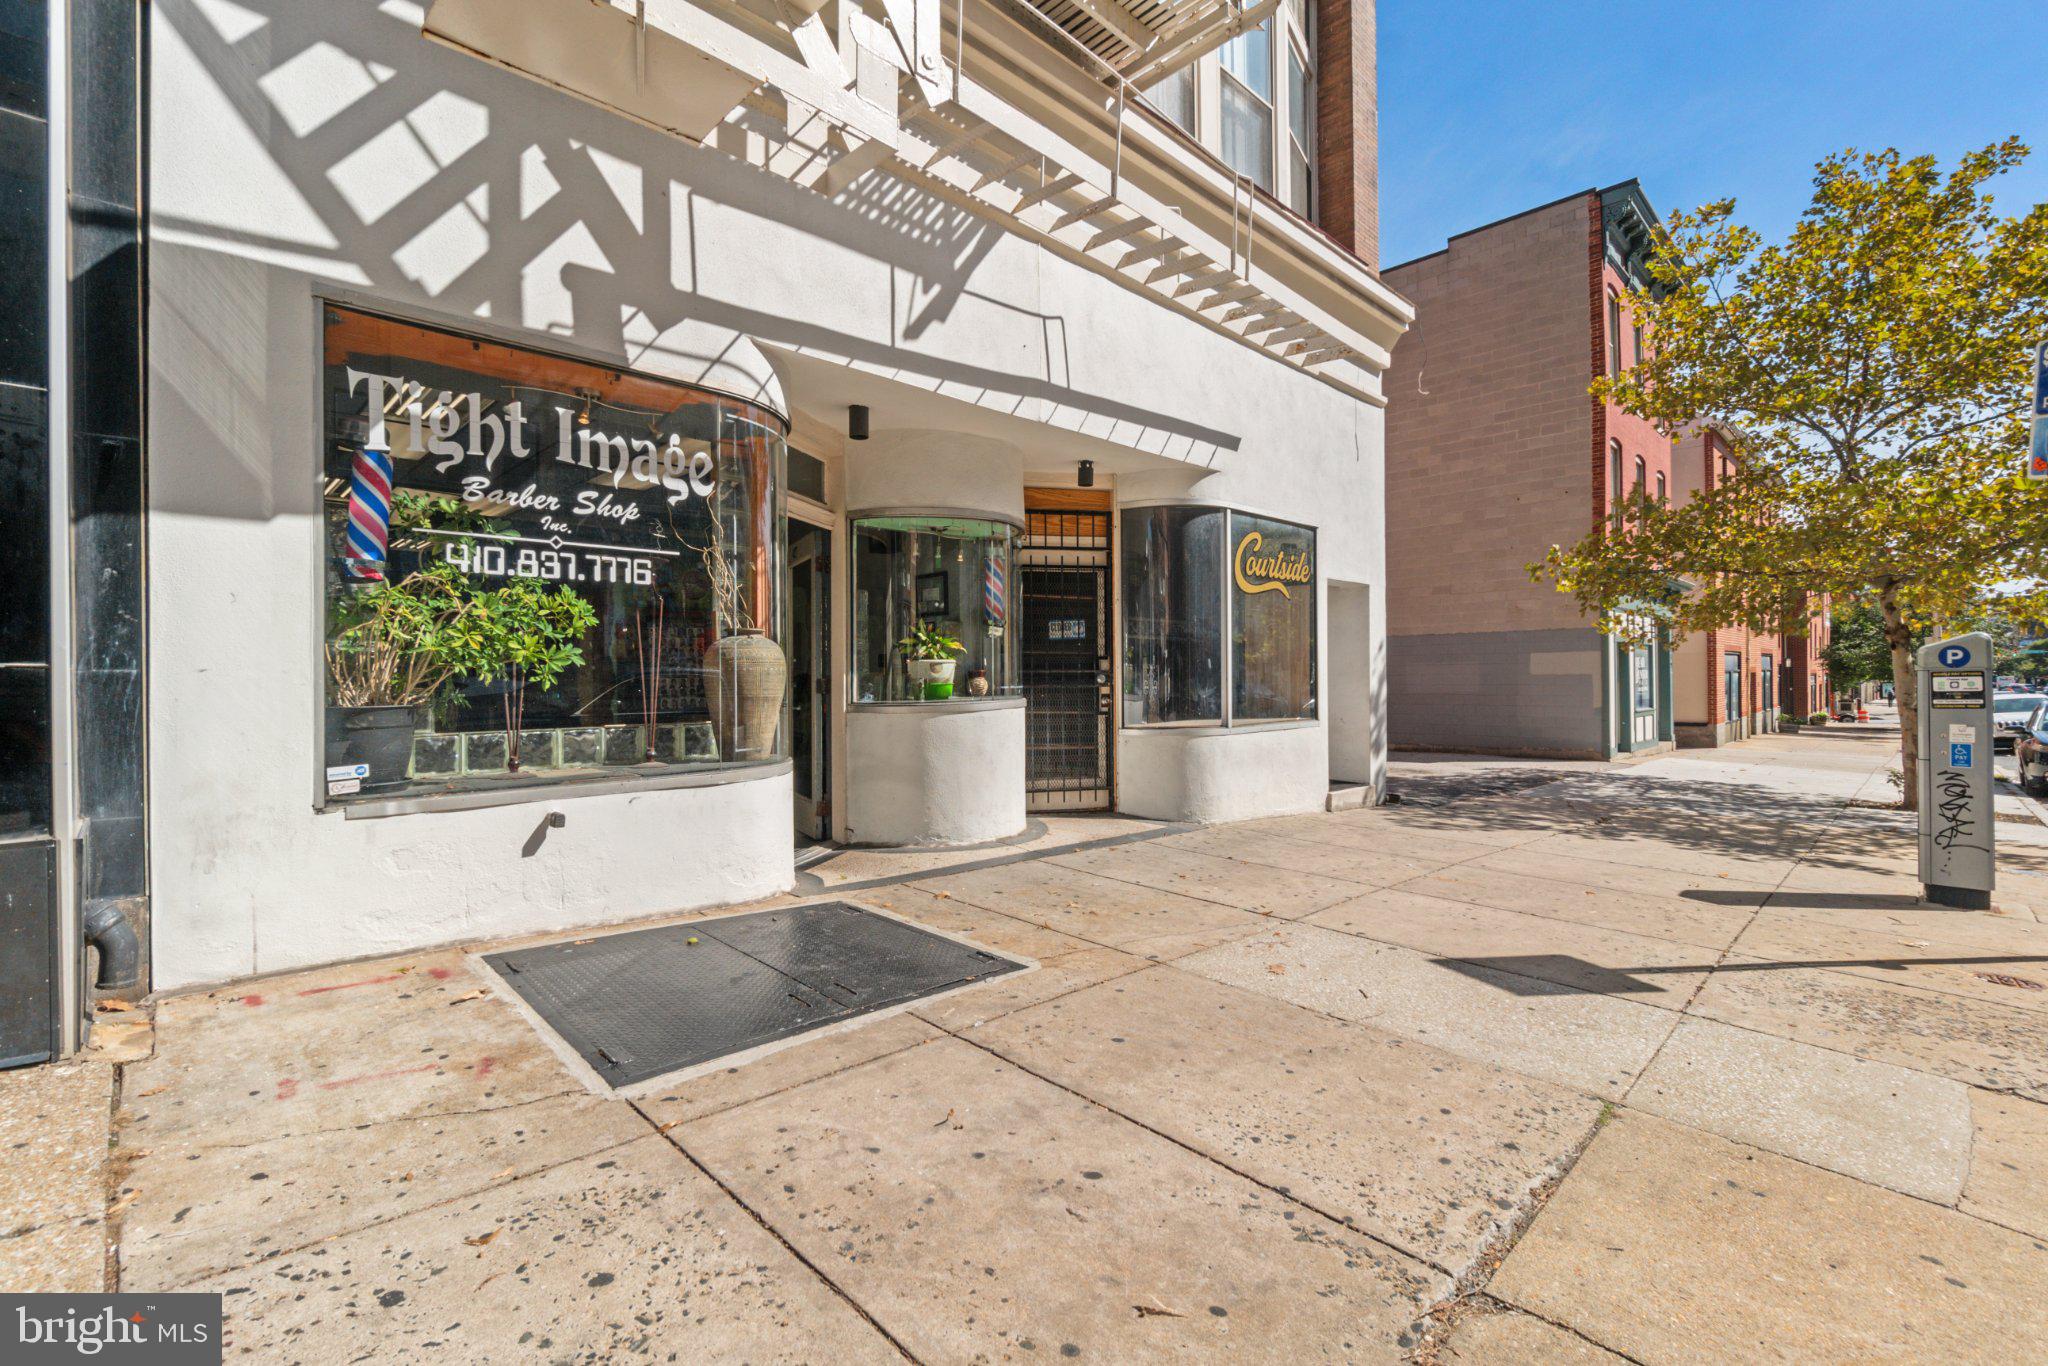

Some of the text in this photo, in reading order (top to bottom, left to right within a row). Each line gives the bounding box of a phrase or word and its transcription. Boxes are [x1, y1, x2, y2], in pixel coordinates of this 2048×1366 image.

[346, 365, 715, 506] Tight Image
[461, 475, 641, 525] Barber Shop
[540, 515, 573, 534] Inc.
[445, 542, 653, 586] 410.837.7776
[1234, 531, 1311, 600] Courtside
[1946, 649, 1964, 664] P
